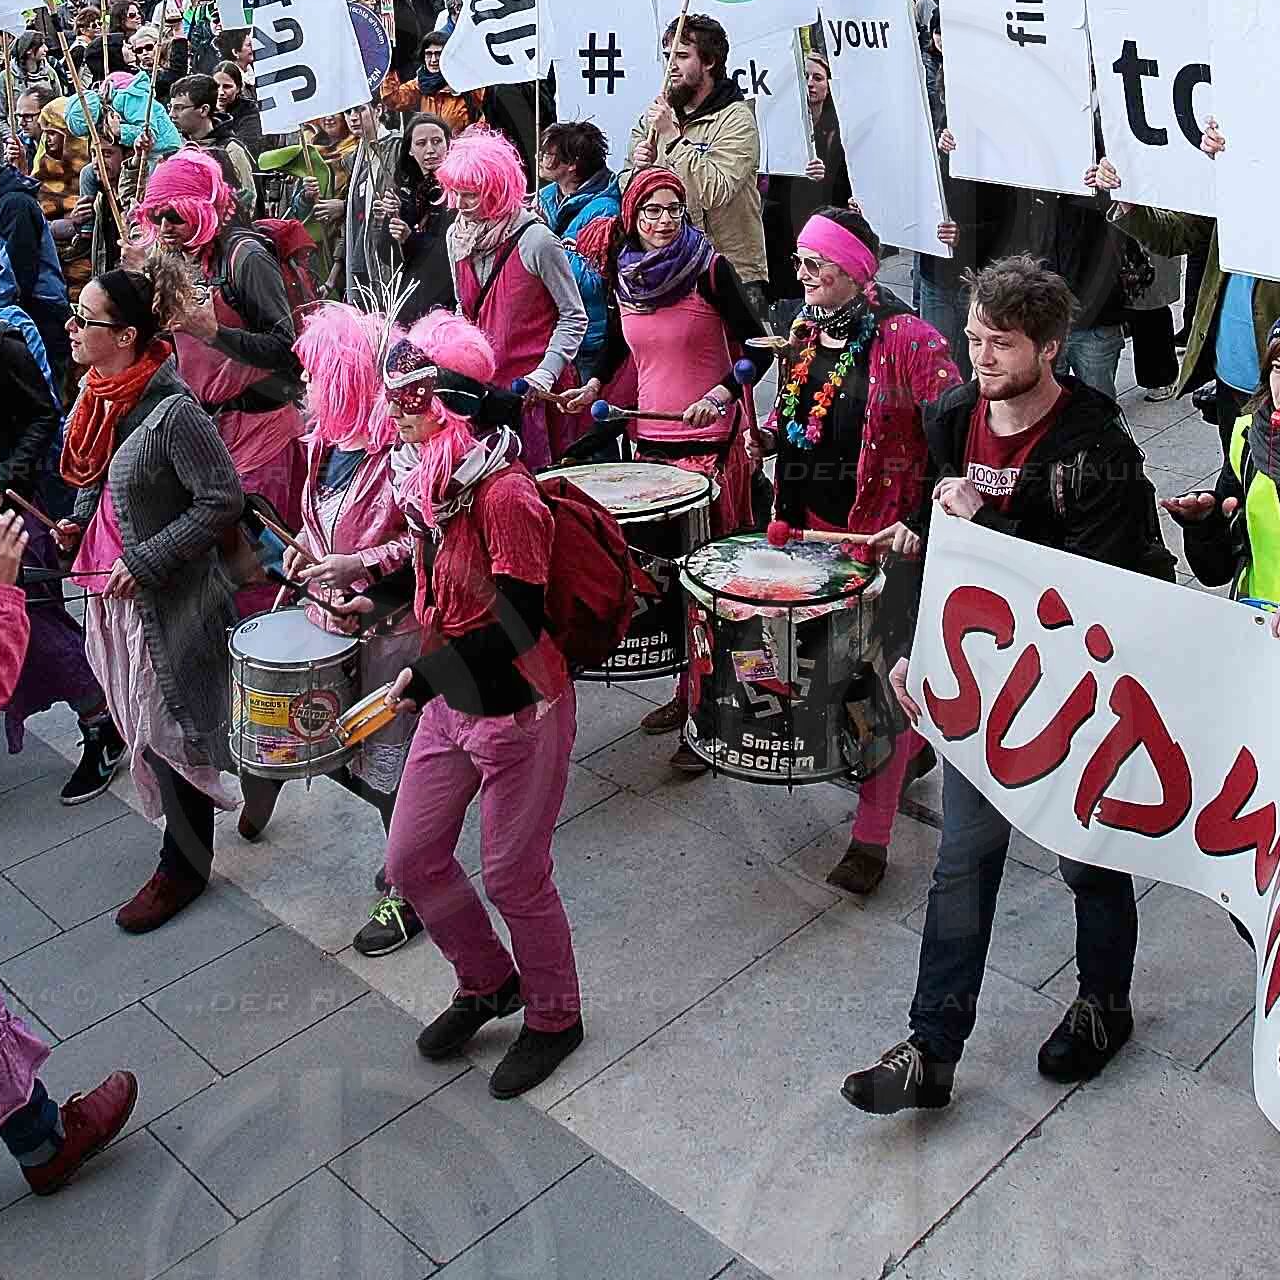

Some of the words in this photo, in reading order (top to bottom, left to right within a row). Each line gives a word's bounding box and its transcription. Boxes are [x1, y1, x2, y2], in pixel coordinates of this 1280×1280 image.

[827, 20, 890, 57] your
[969, 466, 1009, 486] 100%
[741, 732, 805, 751] Smash
